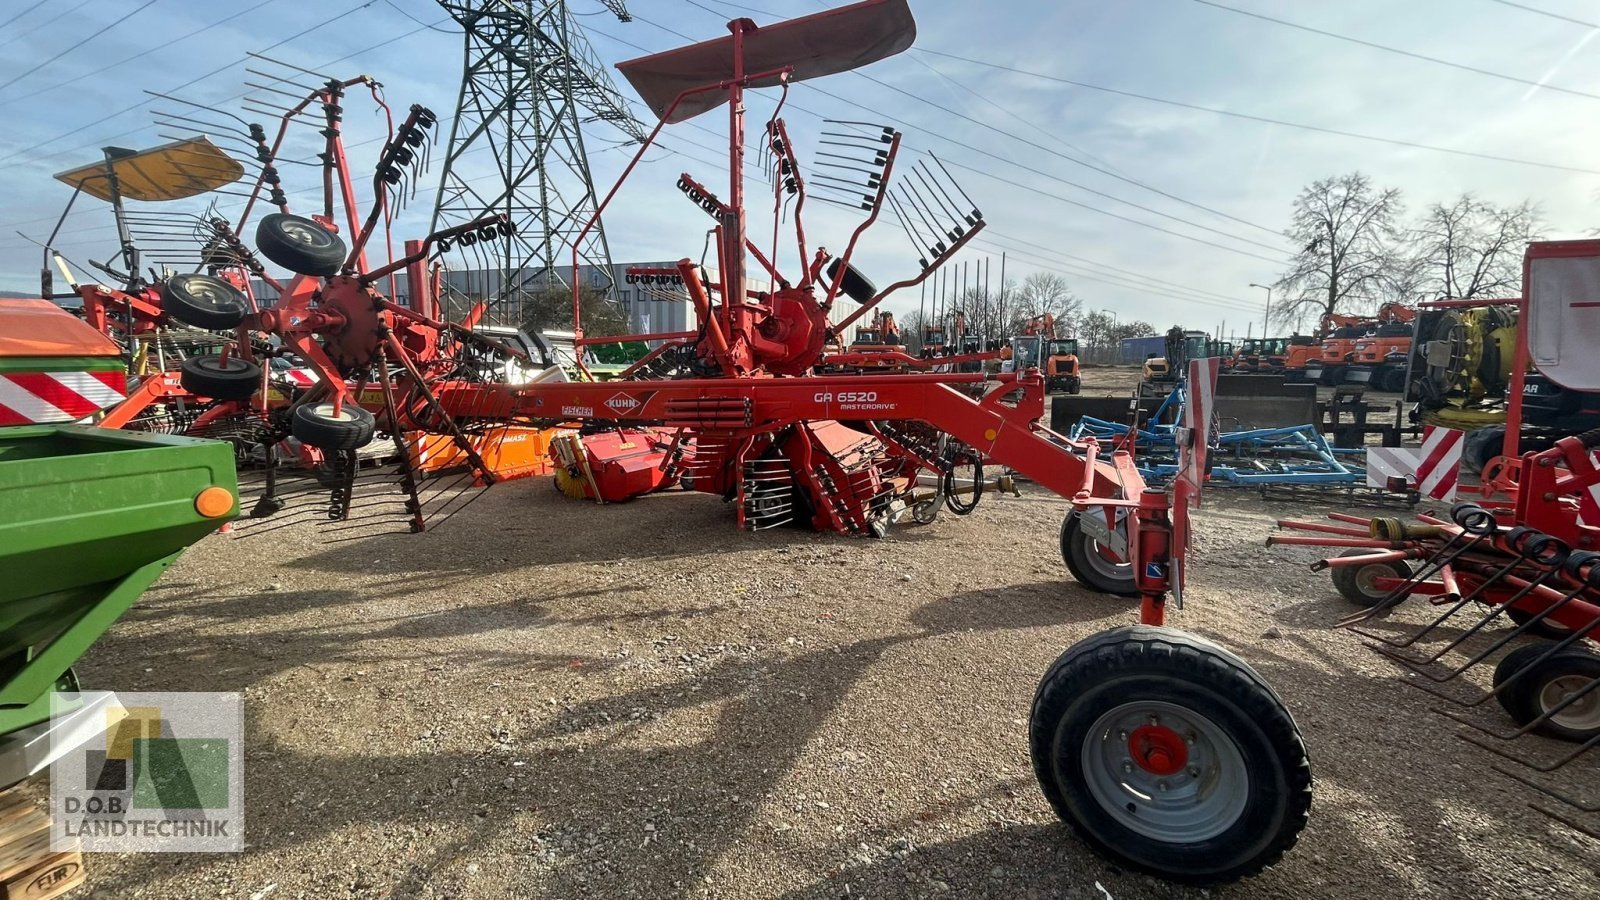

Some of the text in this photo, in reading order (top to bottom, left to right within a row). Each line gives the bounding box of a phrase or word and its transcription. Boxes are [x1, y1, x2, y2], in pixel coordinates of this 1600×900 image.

[814, 391, 877, 403] GA 6520
[608, 399, 636, 408] KUHN
[562, 406, 592, 415] FISCHER
